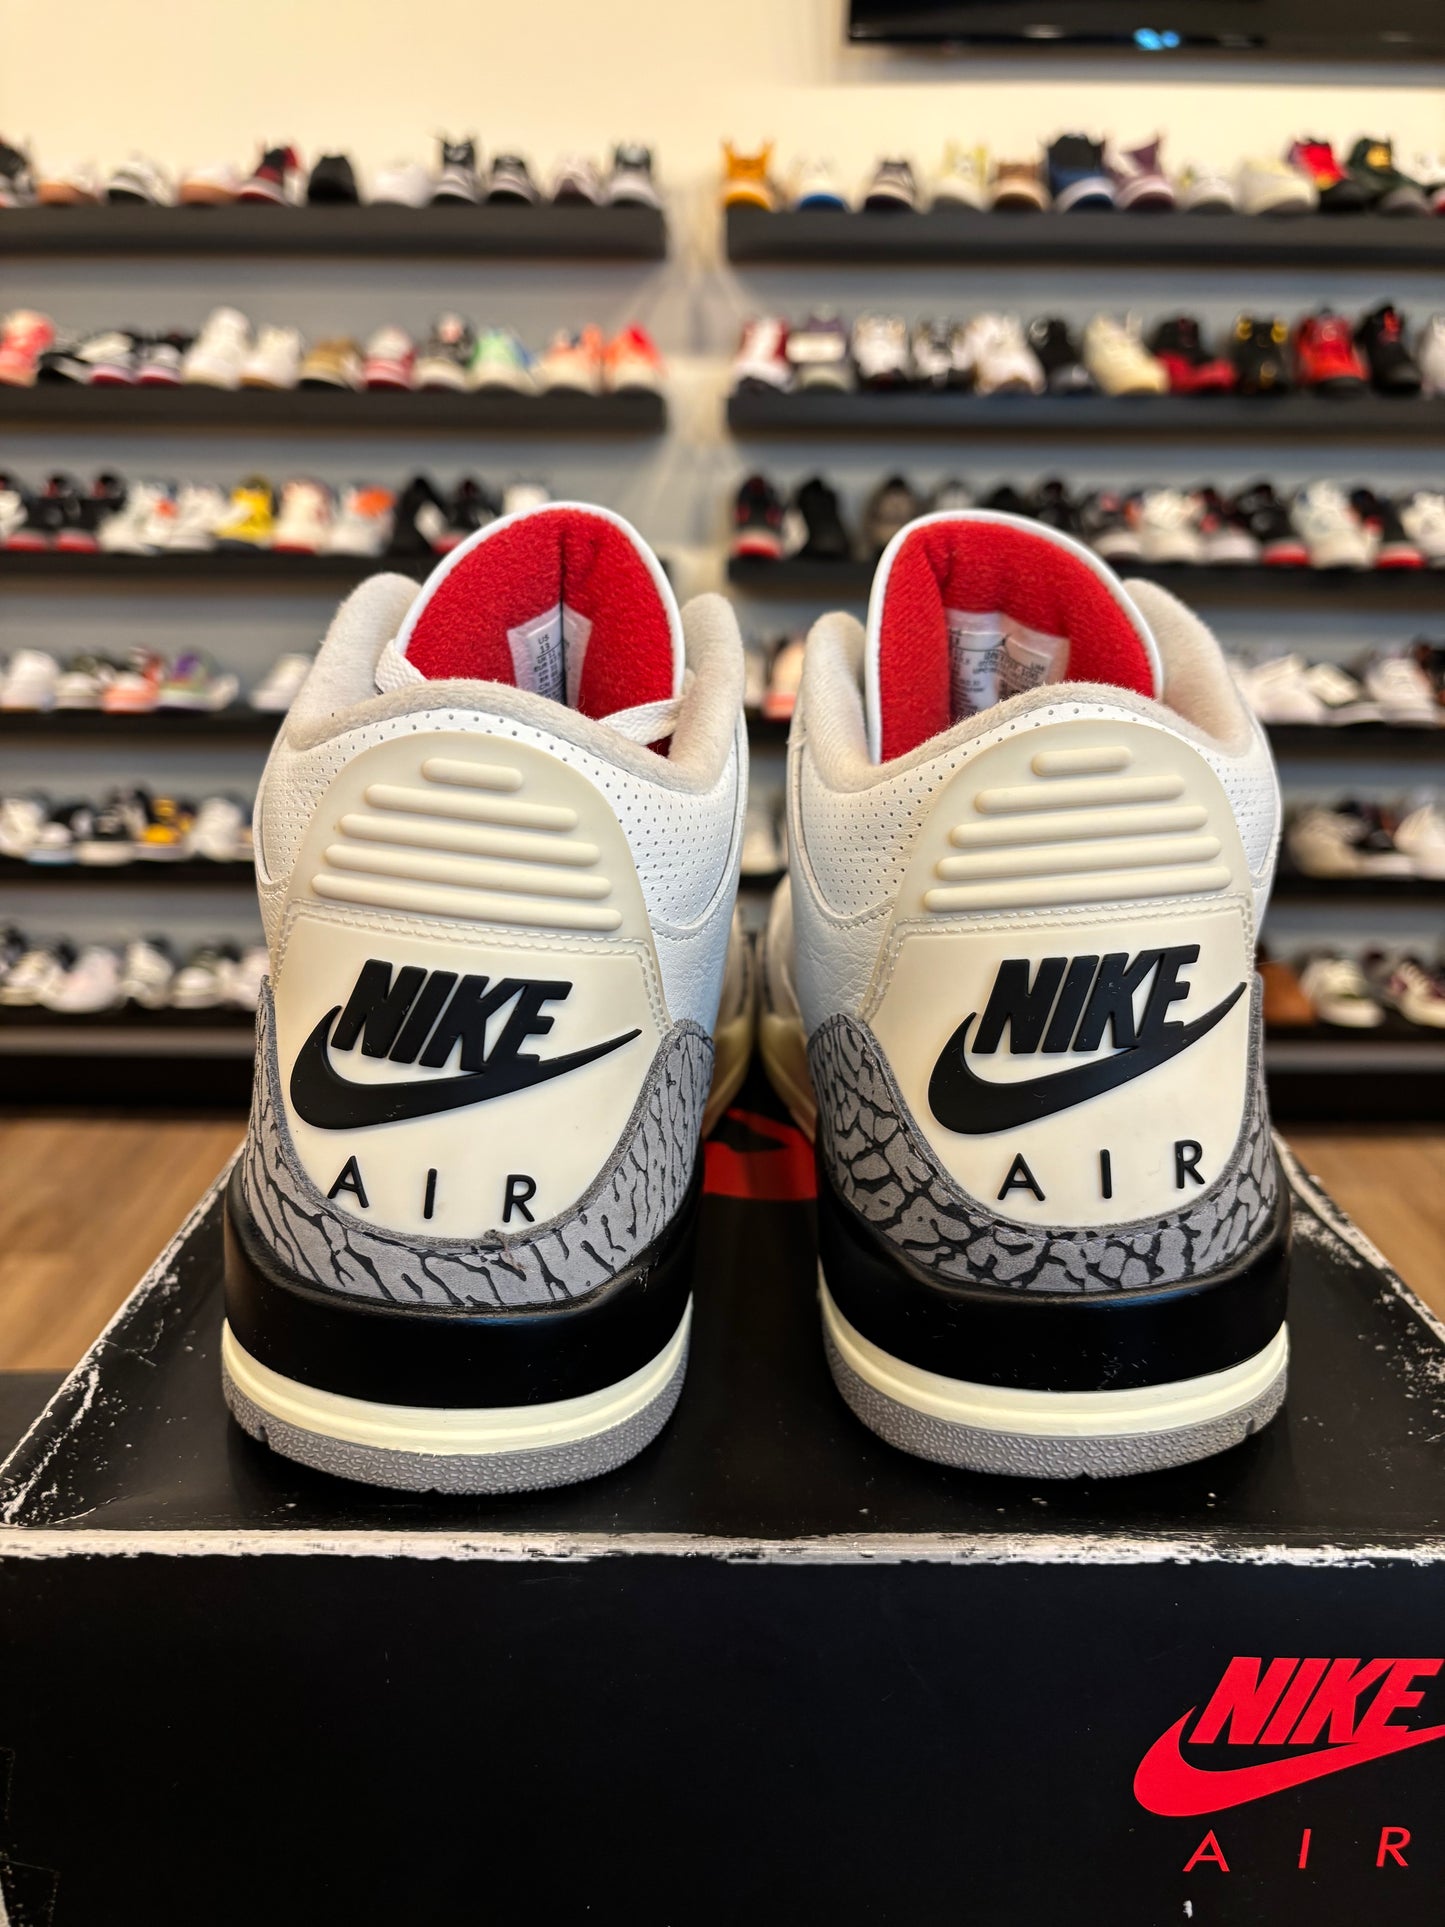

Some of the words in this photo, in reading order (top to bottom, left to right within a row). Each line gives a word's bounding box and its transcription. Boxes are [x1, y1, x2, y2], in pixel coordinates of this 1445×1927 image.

[538, 634, 550, 644] US
[539, 643, 551, 654] 13
[331, 959, 573, 1071] NIKE
[972, 944, 1201, 1054] NIKE
[327, 1155, 538, 1223] AIR
[997, 1139, 1206, 1202] AIR
[1188, 1656, 1445, 1745] NIKE
[1182, 1826, 1412, 1873] AIR
